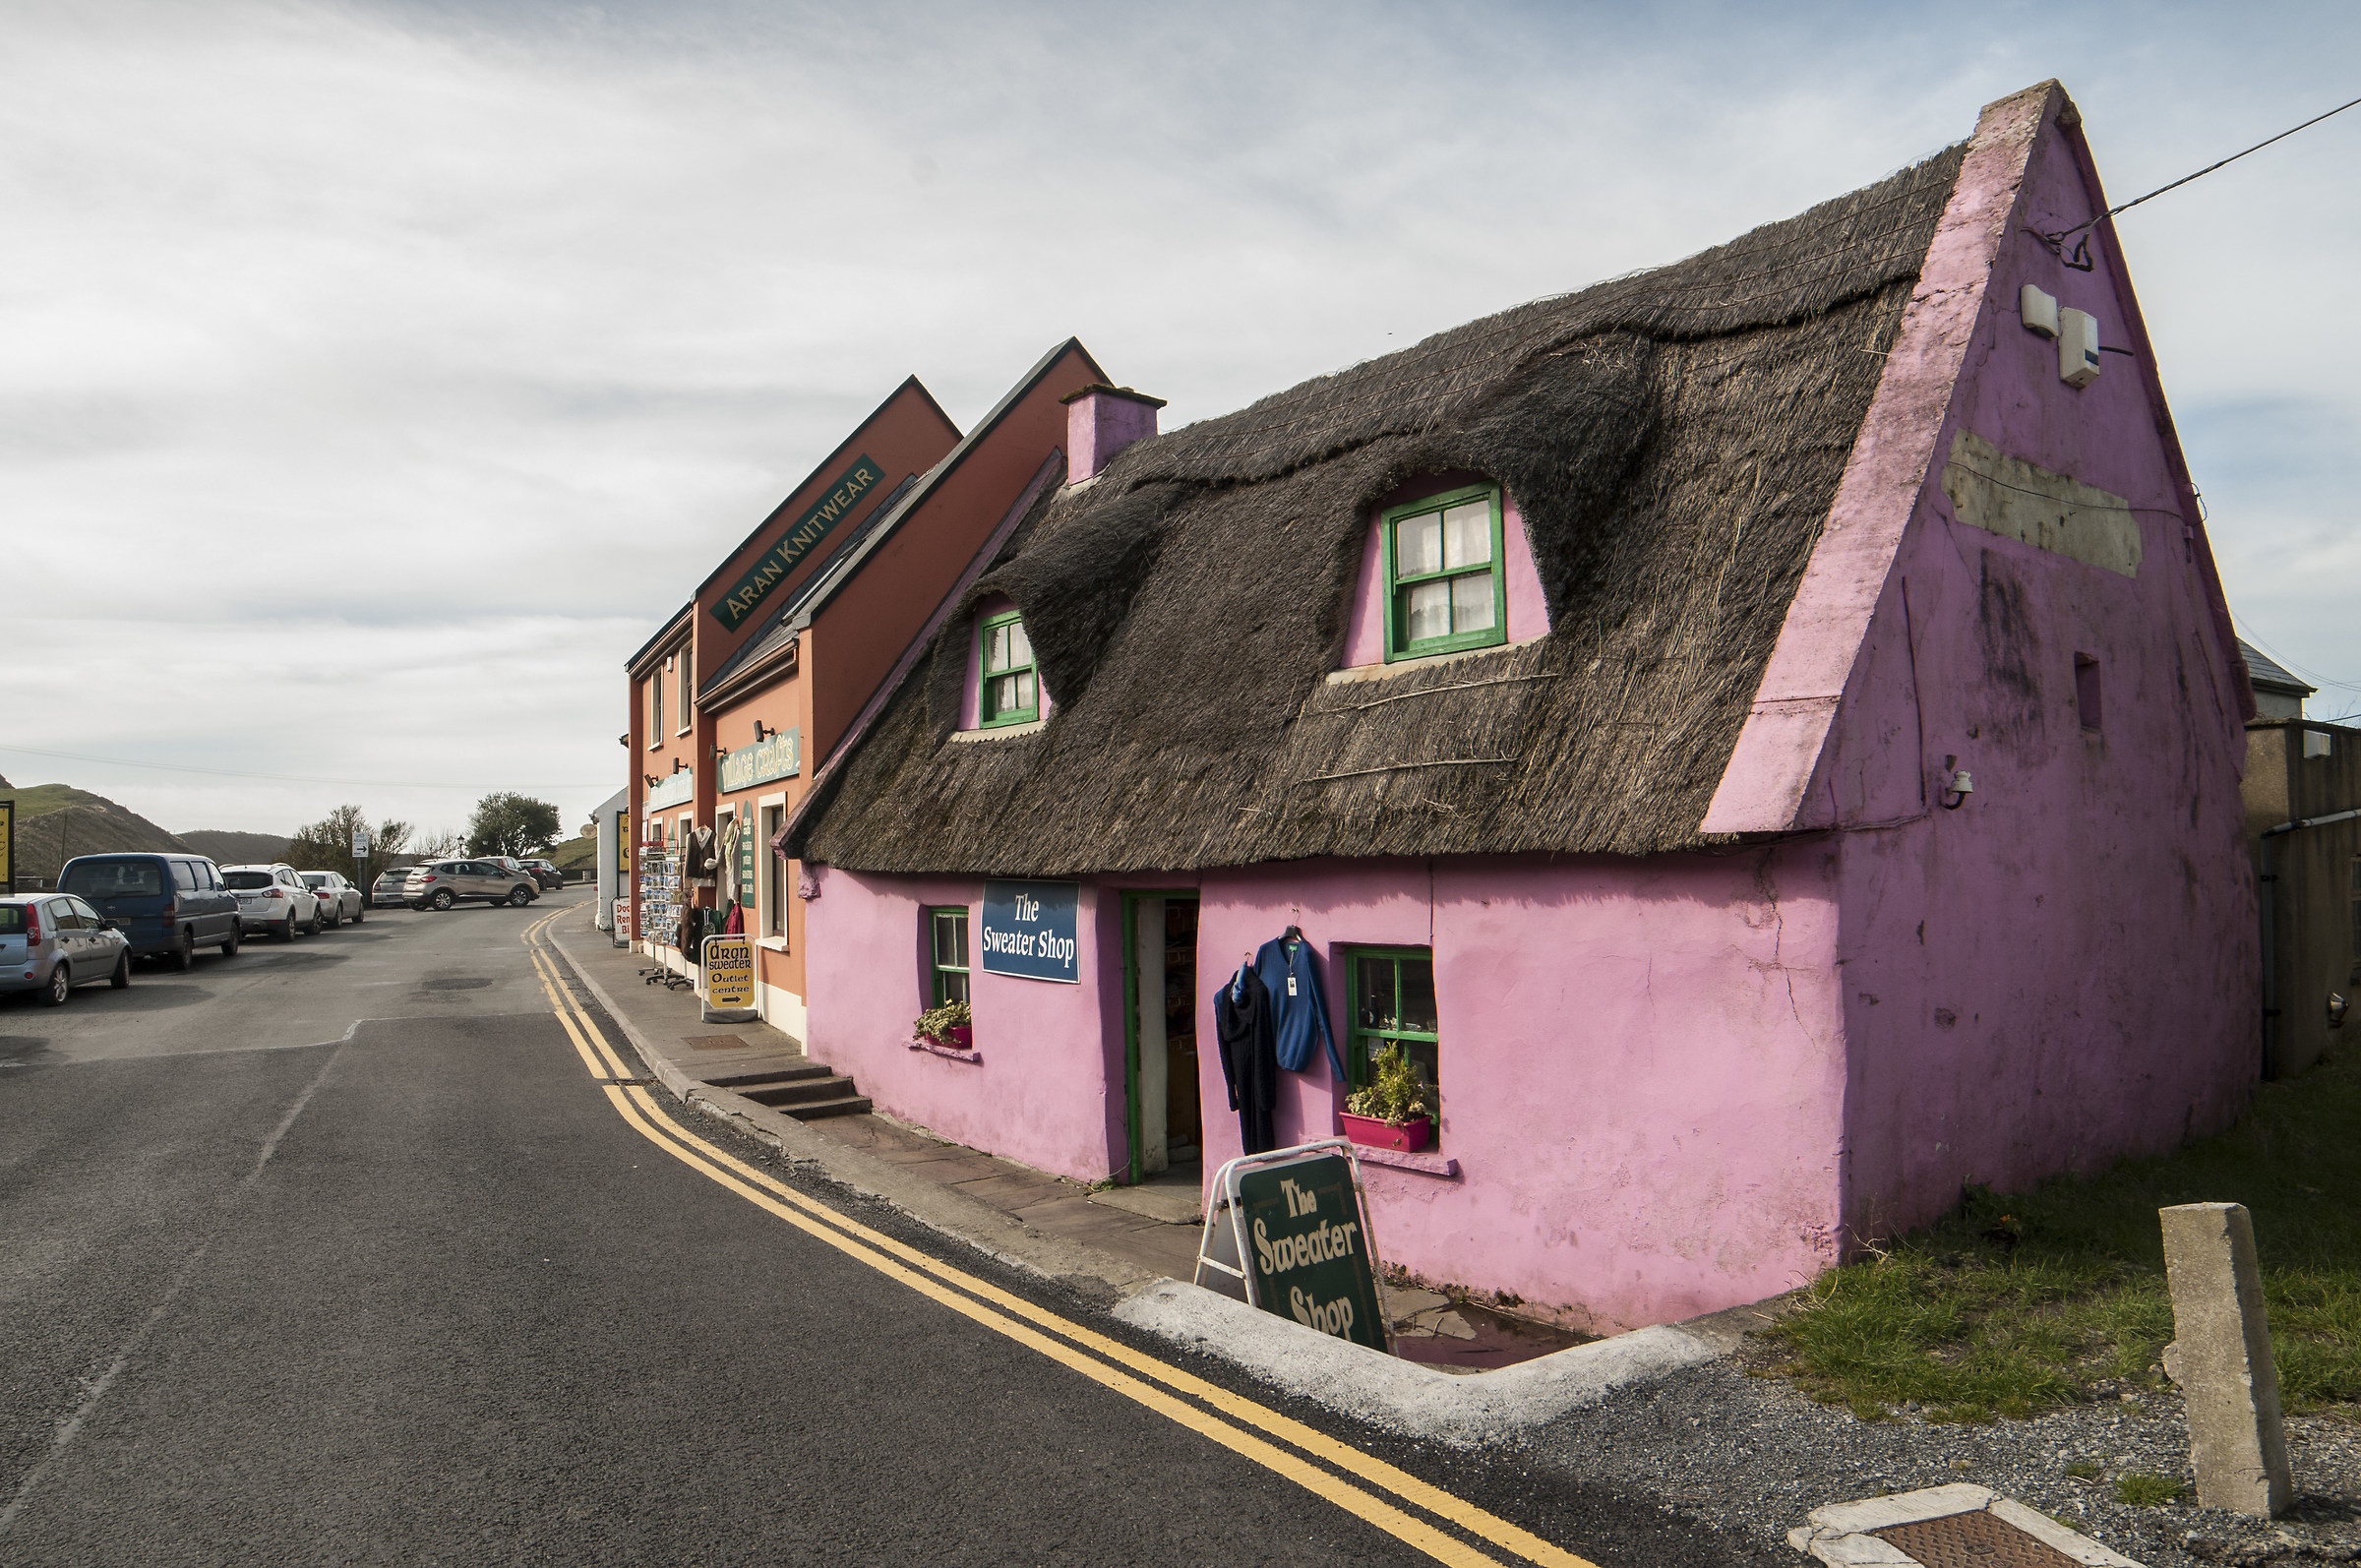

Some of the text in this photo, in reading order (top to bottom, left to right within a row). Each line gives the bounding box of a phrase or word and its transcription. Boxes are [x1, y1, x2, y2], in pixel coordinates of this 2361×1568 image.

[726, 467, 874, 620] ARAN KNITWEAR
[1014, 893, 1039, 922] The
[708, 957, 752, 971] sweater
[709, 944, 750, 960] Aran
[984, 926, 1074, 968] Sweater Shop
[711, 972, 750, 983] Outlet
[1280, 1177, 1317, 1218] The
[1253, 1218, 1358, 1275] Sweater
[1290, 1286, 1354, 1342] Shop
